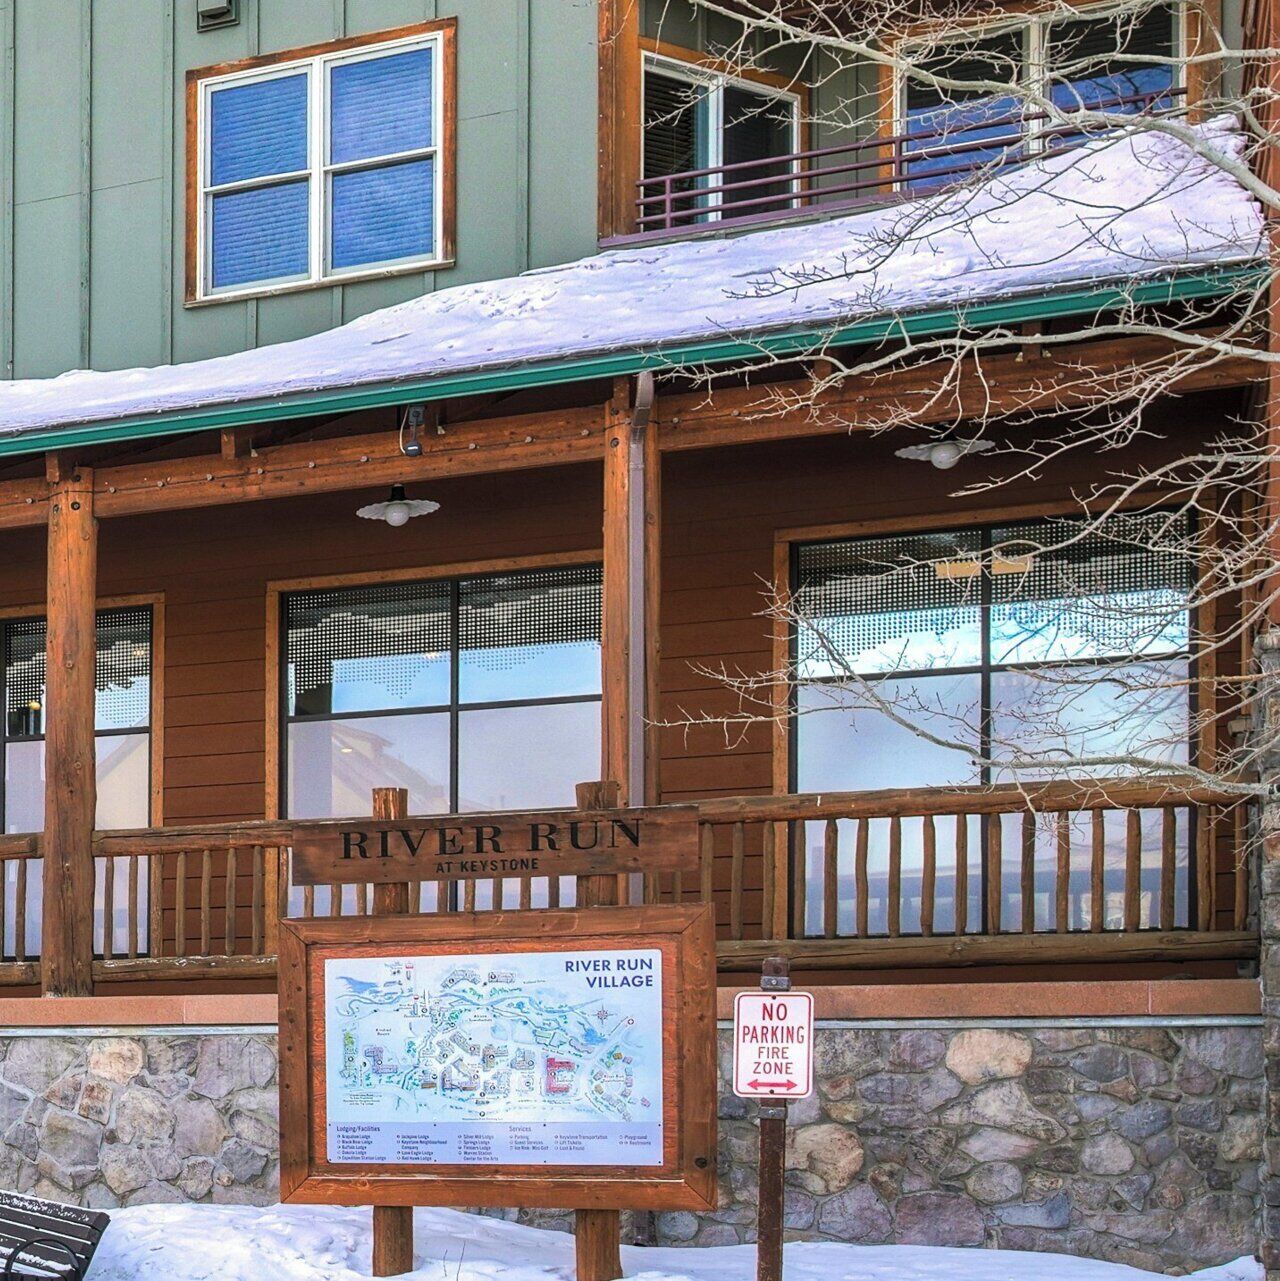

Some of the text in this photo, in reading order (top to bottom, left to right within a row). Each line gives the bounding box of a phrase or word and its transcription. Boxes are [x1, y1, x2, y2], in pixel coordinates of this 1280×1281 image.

[339, 818, 643, 859] RIVER RUN
[436, 858, 539, 873] AT KEYSTONE
[565, 958, 653, 972] RIVER RUN
[586, 975, 653, 988] VILLAGE
[762, 1003, 788, 1021] NO
[742, 1025, 805, 1044] PARKING
[758, 1046, 789, 1059] FIRE
[753, 1061, 793, 1075] ZONE
[336, 1125, 380, 1133] Lodging/Facilities
